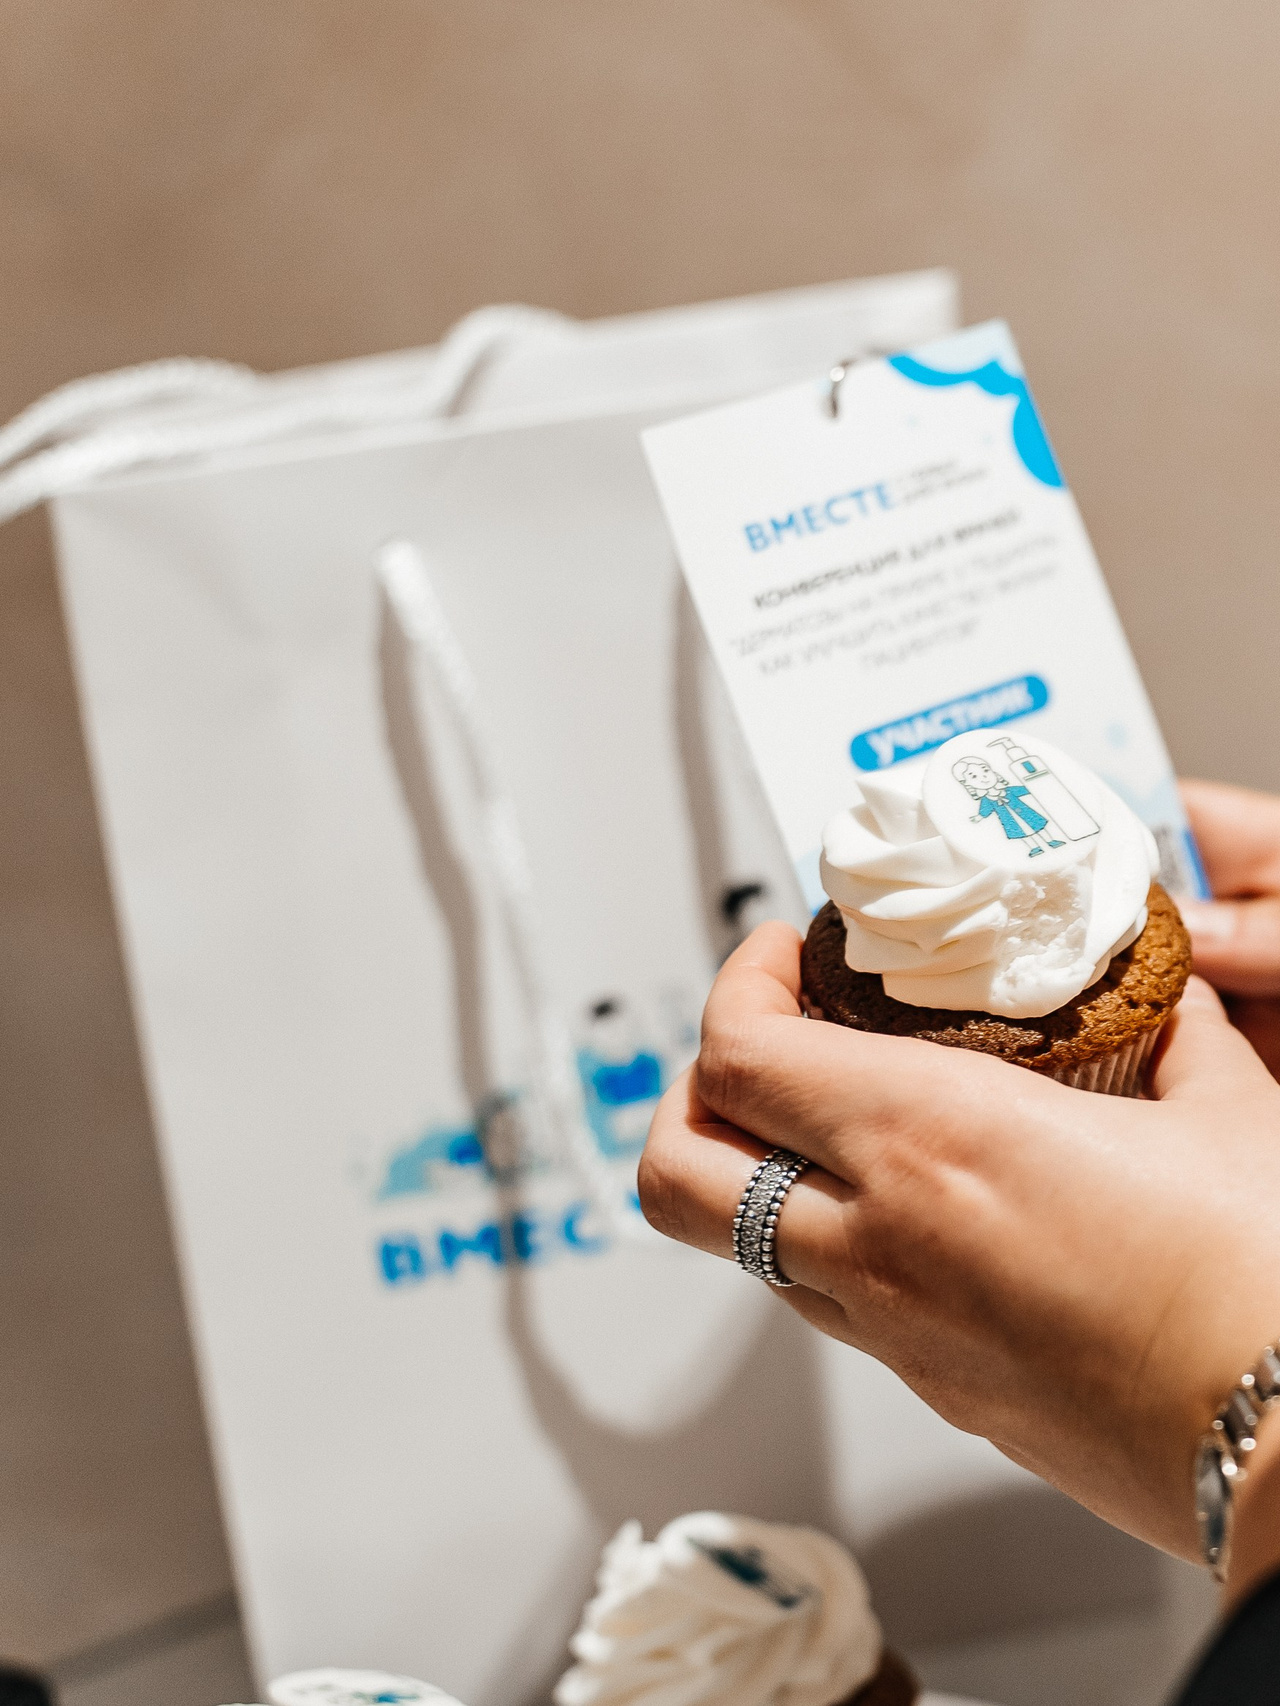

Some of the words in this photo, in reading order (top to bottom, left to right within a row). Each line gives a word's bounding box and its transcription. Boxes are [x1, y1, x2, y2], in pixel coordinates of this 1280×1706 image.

[743, 478, 899, 554] ВМЕСТЕ
[868, 682, 1034, 764] УЧАСТНИК
[376, 1194, 640, 1284] ВМЕС
